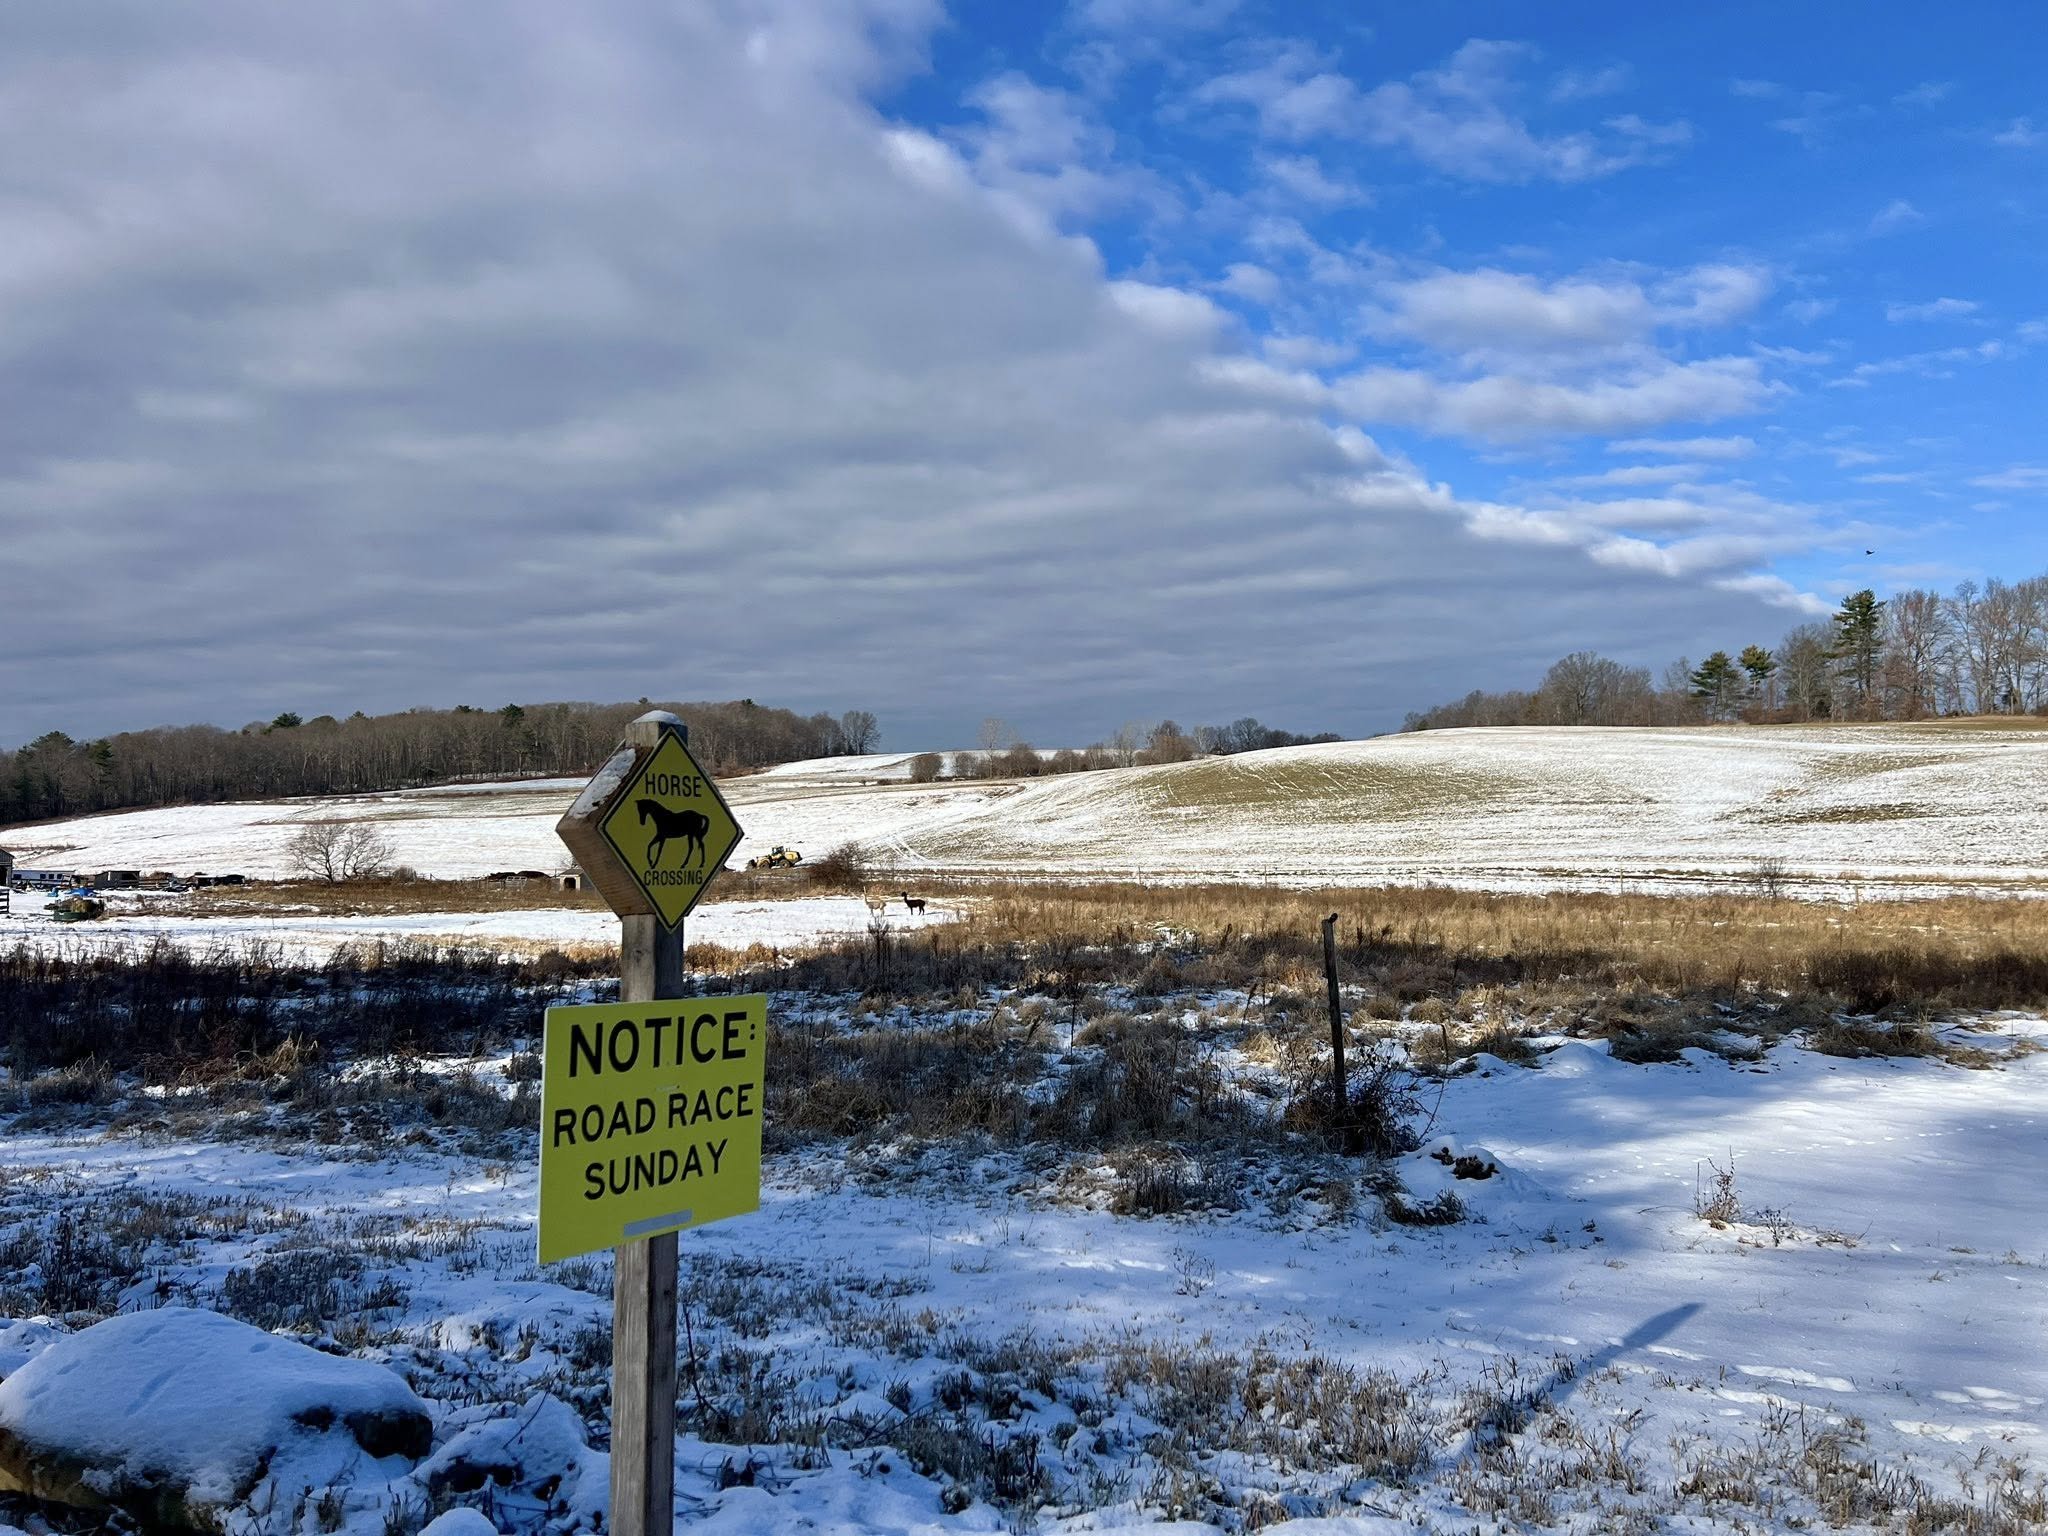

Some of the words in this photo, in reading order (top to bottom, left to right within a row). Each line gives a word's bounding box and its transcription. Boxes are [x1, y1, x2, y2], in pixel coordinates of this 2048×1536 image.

[645, 773, 702, 797] HORSE
[644, 869, 703, 886] CROSSING
[568, 1011, 756, 1078] NOTICE:
[553, 1098, 656, 1148] ROAD
[668, 1083, 754, 1129] RACE
[584, 1138, 728, 1200] SUNDAY
